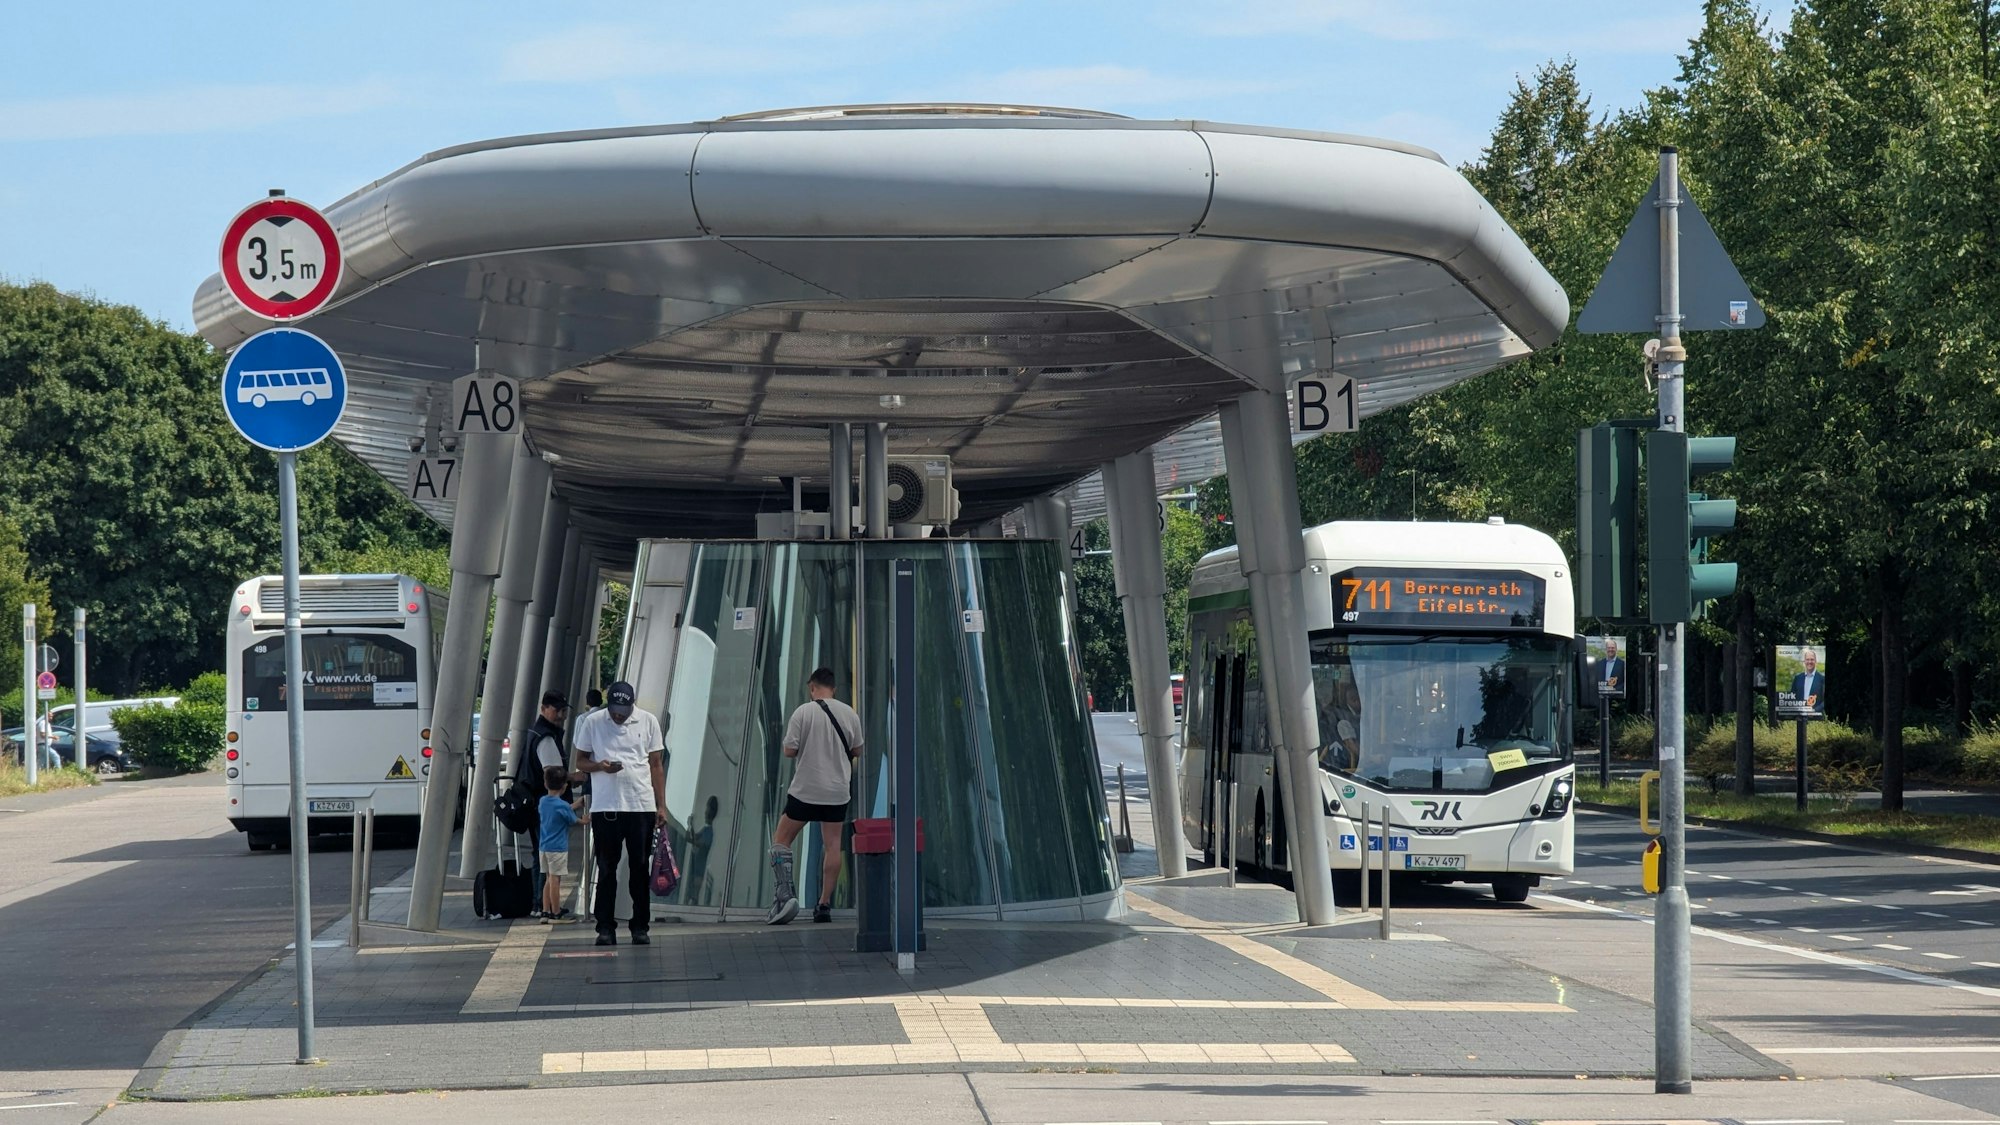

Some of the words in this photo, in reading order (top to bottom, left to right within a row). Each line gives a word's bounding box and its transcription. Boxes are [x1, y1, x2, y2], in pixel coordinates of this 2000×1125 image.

[248, 236, 294, 283] 3,5
[300, 263, 317, 279] m
[458, 380, 515, 431] A8
[1298, 379, 1354, 431] B1
[412, 459, 456, 499] A7
[1341, 579, 1392, 610] 711
[1404, 580, 1521, 596] Berrenrath
[1418, 599, 1506, 614] Eifelstr.
[1342, 611, 1360, 622] 497
[254, 645, 267, 654] 498
[315, 673, 378, 683] www.rvk.de
[1779, 692, 1796, 700] Dirk
[316, 802, 322, 810] K
[1414, 856, 1421, 866] K
[1428, 856, 1441, 867] ZY
[1442, 856, 1460, 867] 497
